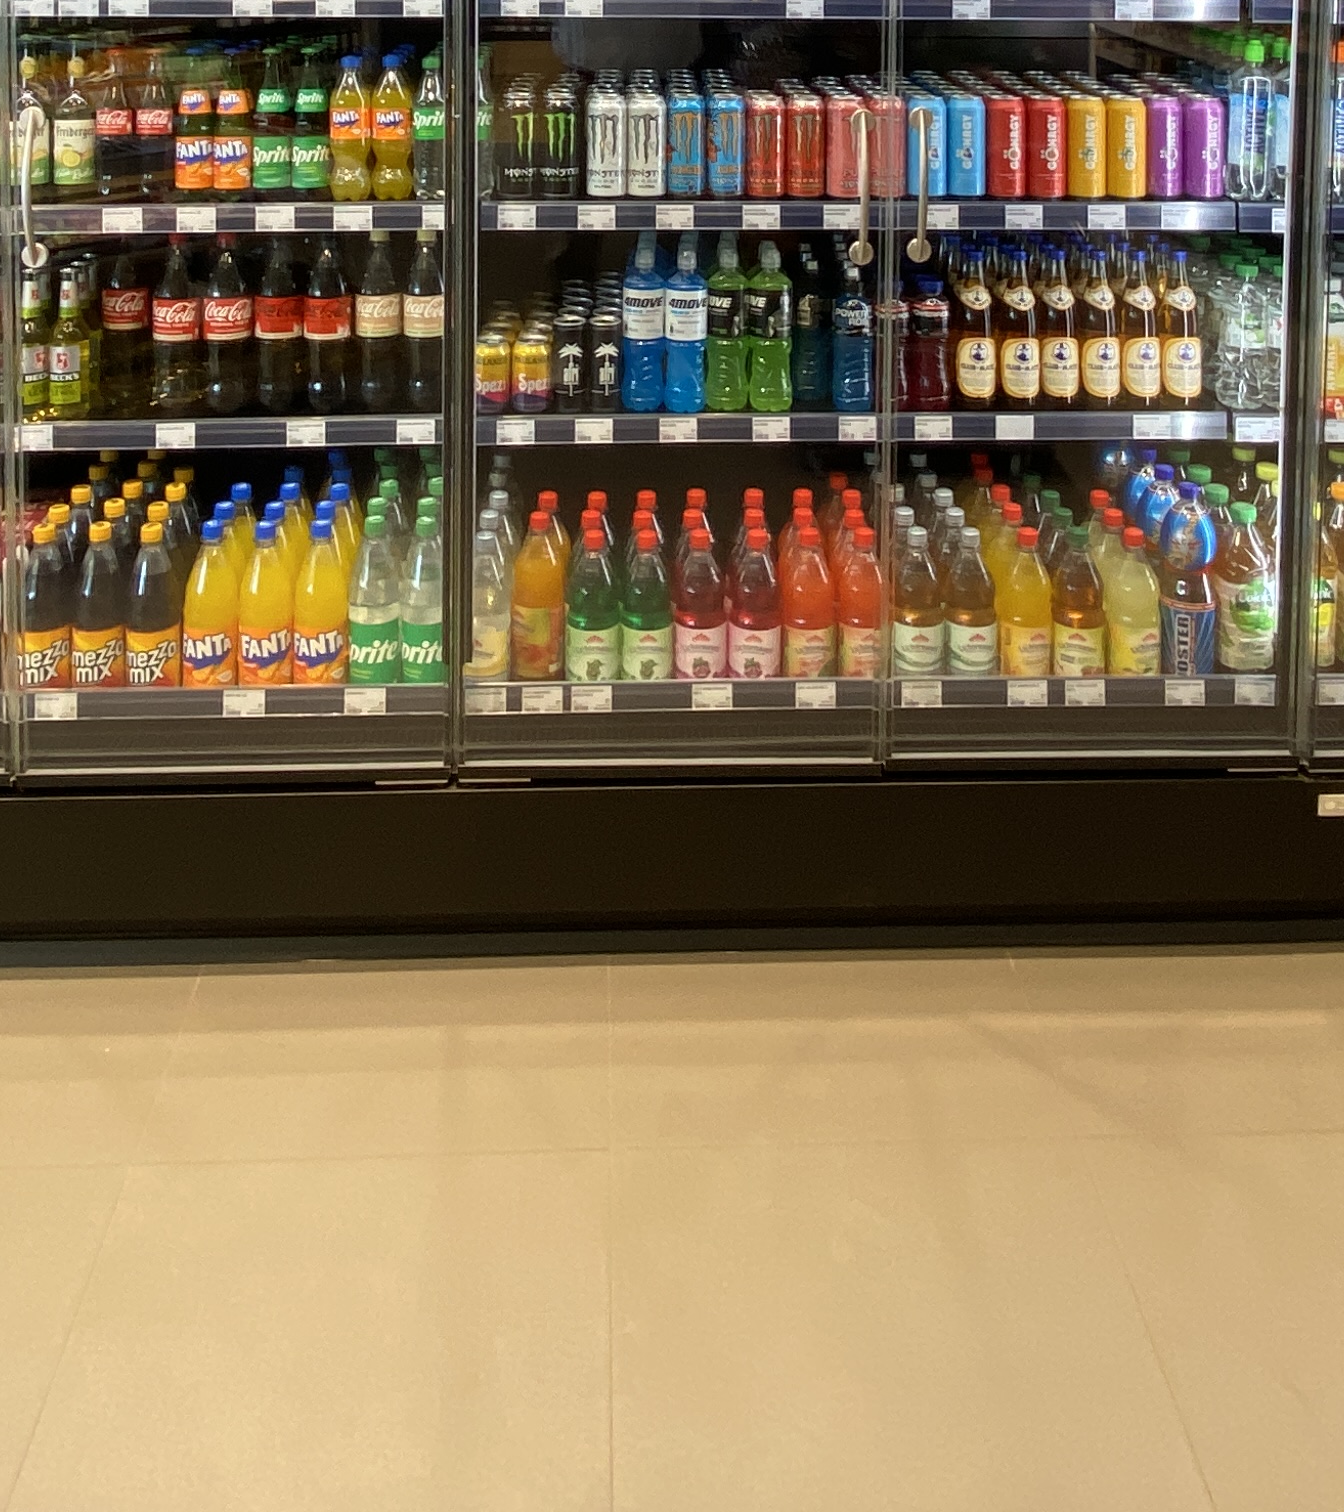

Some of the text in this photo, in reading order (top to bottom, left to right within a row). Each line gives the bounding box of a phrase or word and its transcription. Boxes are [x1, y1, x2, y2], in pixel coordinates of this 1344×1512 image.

[182, 92, 205, 104] FANTA
[258, 91, 285, 104] Sprite
[297, 91, 324, 104] Sprite
[332, 110, 360, 124] FANTA
[376, 110, 405, 125] FANTA
[413, 109, 445, 130] Sprit
[624, 296, 663, 308] 4MOVE
[72, 639, 123, 668] mezzo
[126, 640, 177, 668] mezzo
[349, 639, 399, 665] prite
[402, 640, 444, 665] prite
[1177, 614, 1191, 676] OSTER
[76, 656, 112, 684] mix
[129, 657, 165, 684] mix
